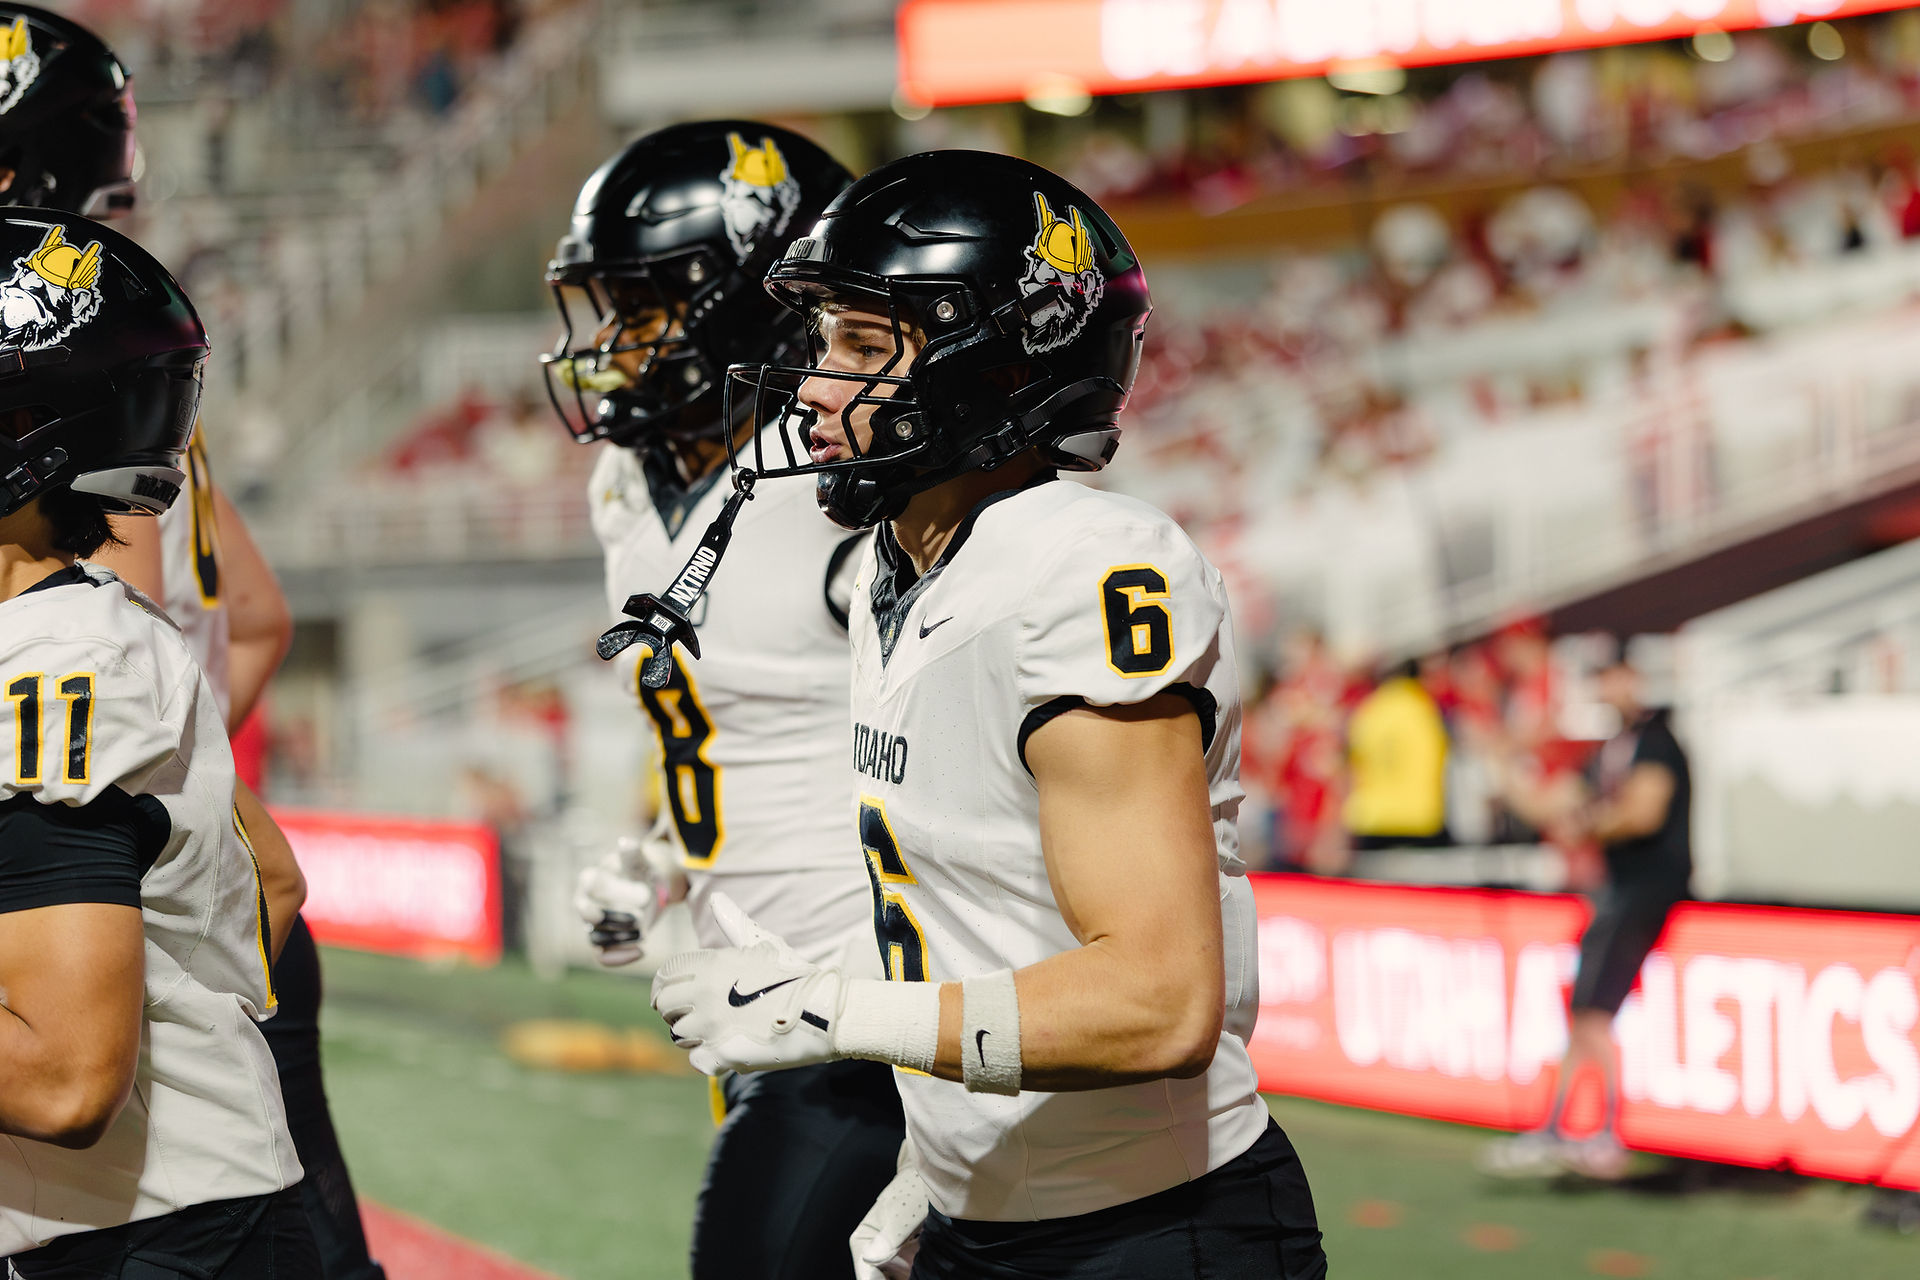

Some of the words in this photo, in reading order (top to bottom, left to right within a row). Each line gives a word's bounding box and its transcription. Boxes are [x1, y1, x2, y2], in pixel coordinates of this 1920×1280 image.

[654, 616, 667, 629] PRO
[668, 545, 717, 607] NXTRND
[1098, 563, 1175, 679] 6
[5, 671, 96, 785] 11
[635, 645, 726, 869] 8
[854, 722, 908, 785] IDAHO
[857, 790, 931, 982] 6
[1507, 940, 1920, 1138] ALETICS
